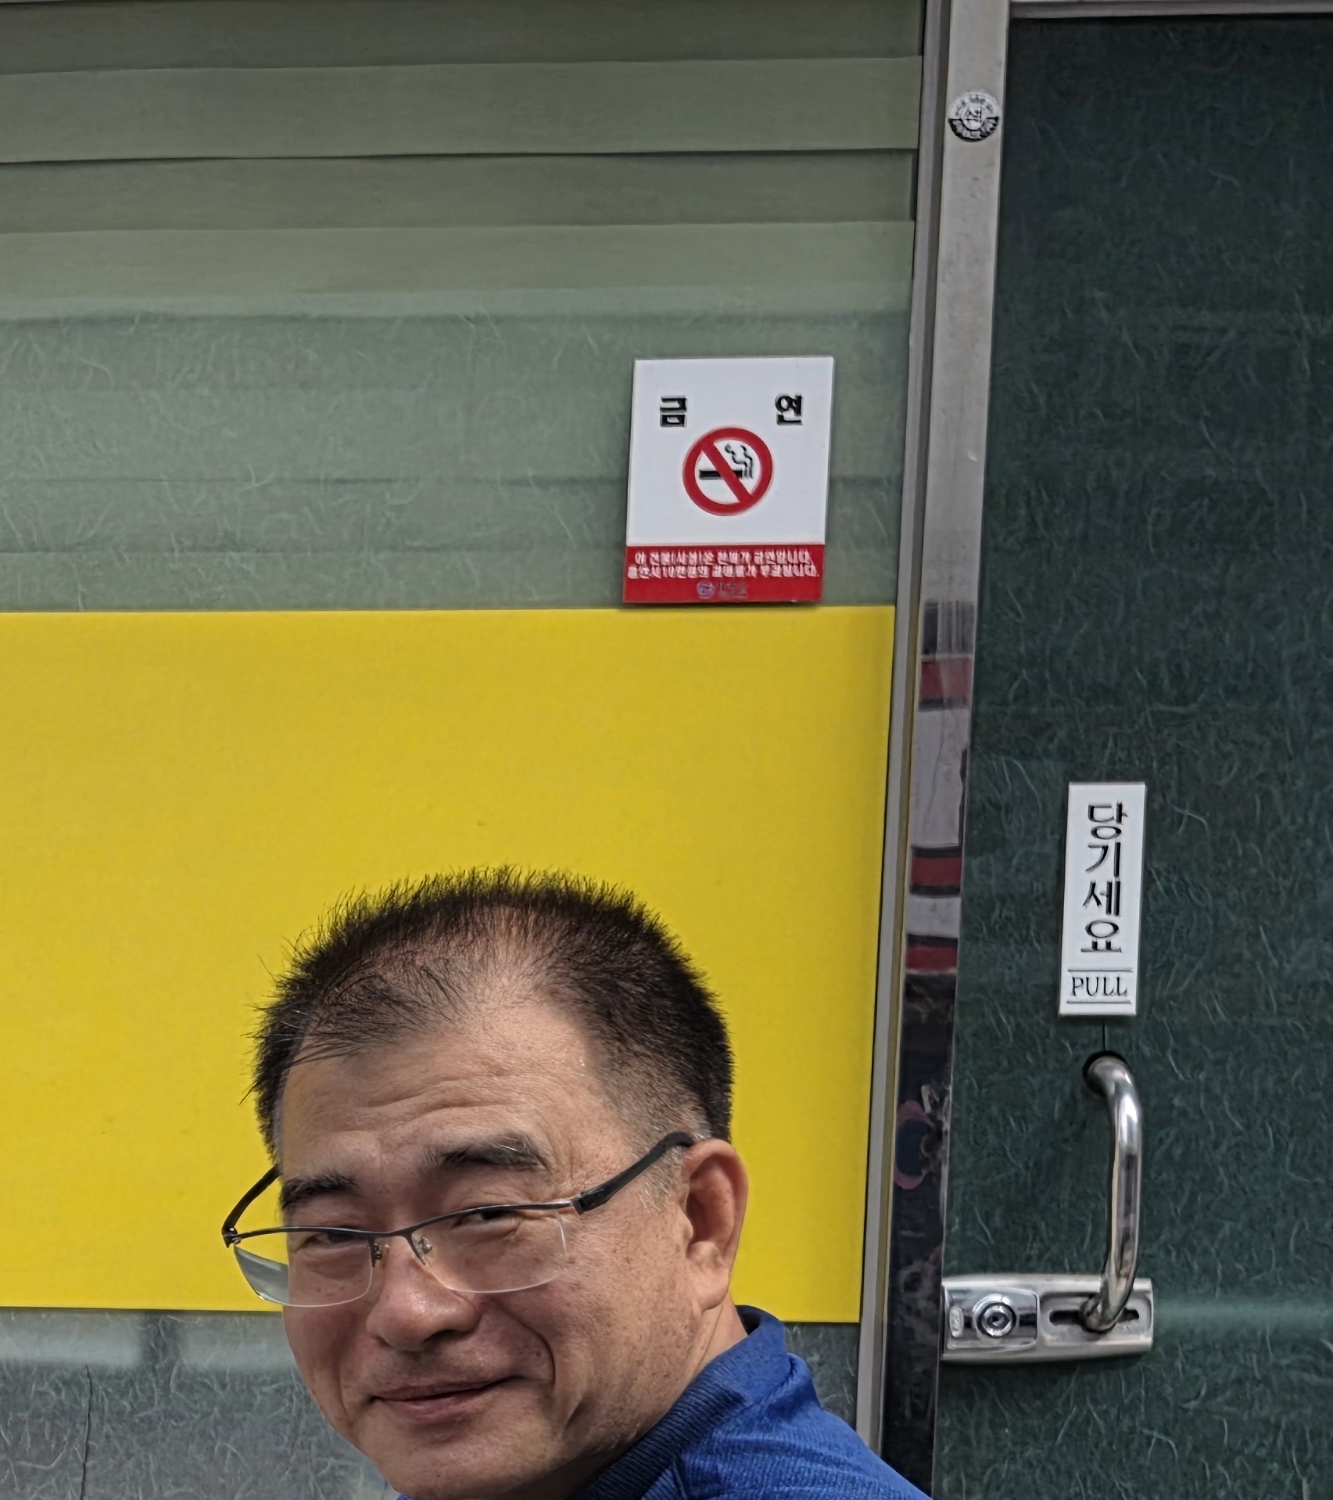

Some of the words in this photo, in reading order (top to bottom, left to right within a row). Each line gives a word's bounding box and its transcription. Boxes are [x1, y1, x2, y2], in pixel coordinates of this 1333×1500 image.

[659, 395, 687, 427] 금
[775, 393, 804, 426] 연
[1081, 801, 1129, 953] 당기세요
[1070, 976, 1128, 997] PULL
